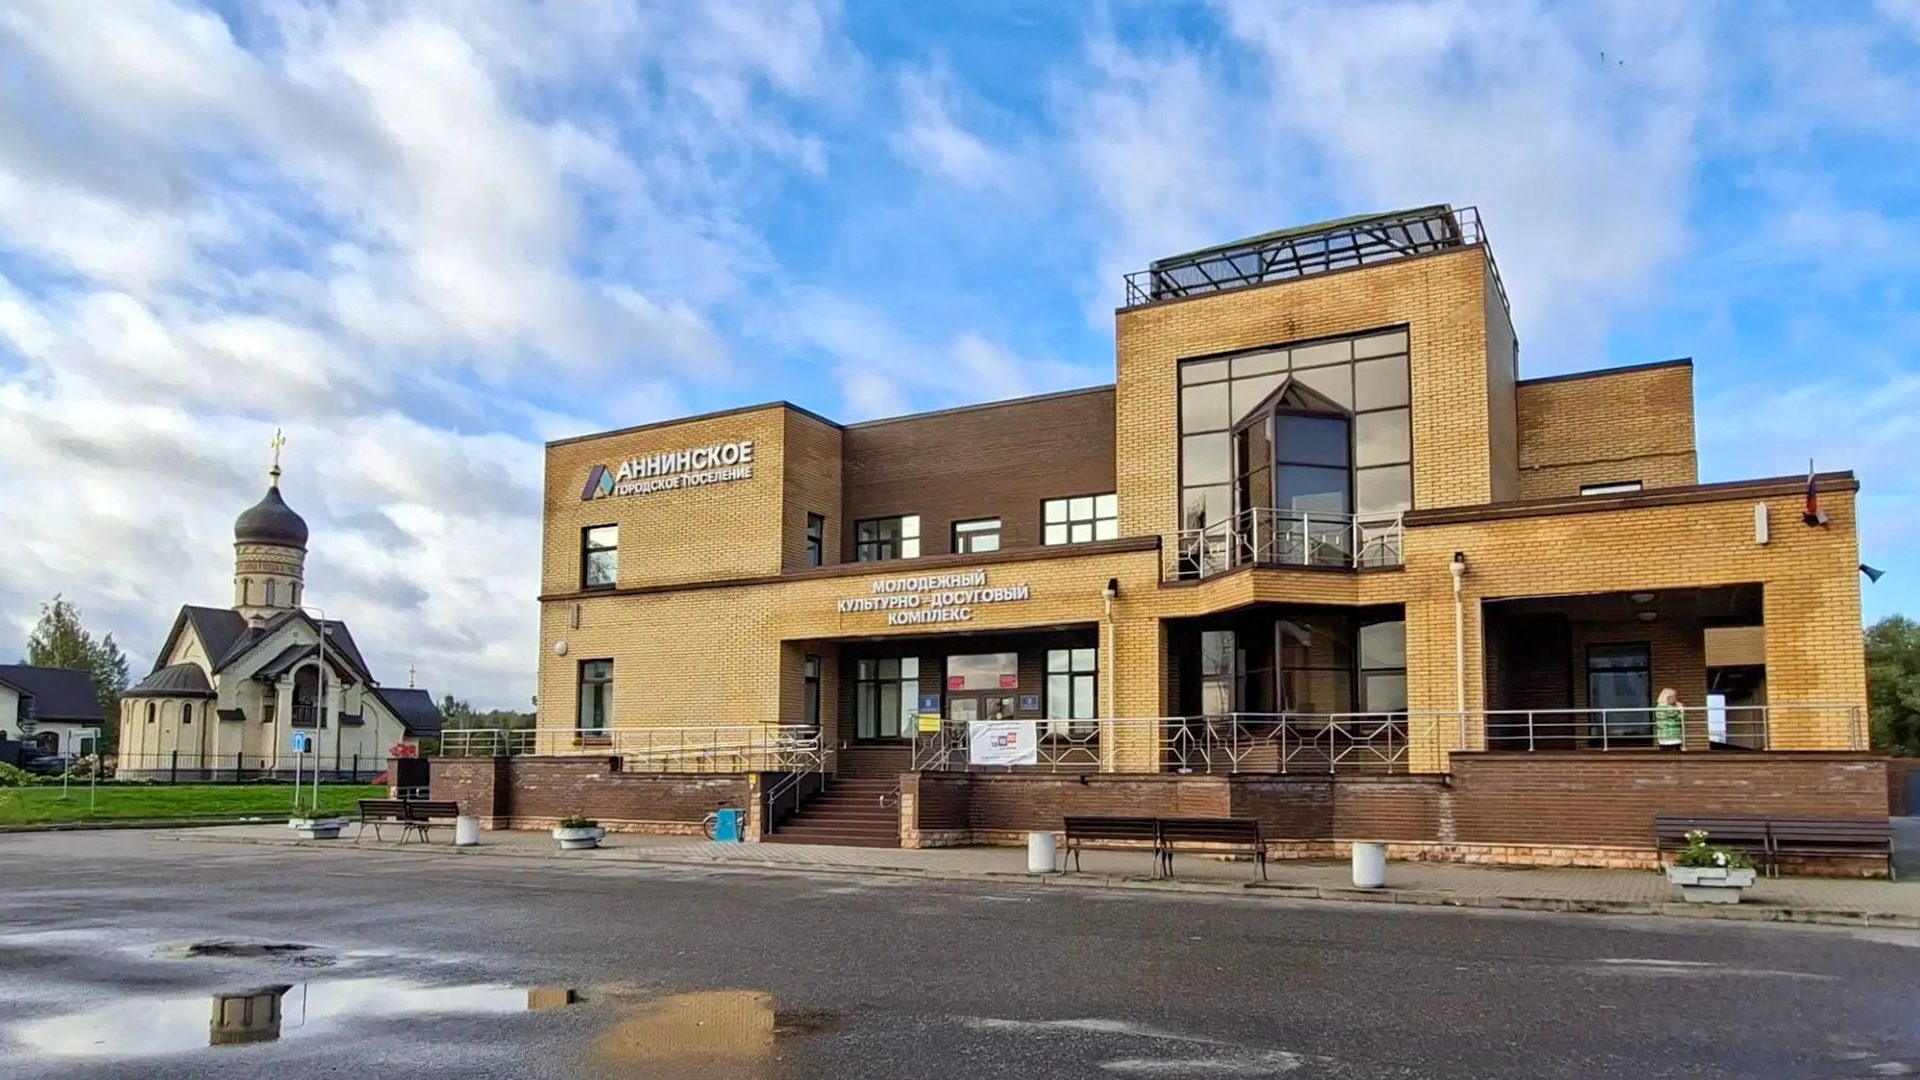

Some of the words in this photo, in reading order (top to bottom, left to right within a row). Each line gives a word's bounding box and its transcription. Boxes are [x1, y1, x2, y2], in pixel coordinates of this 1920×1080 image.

[616, 441, 753, 482] АННИНСКОЕ
[615, 478, 680, 495] ГОРОДСКОЕ
[683, 467, 752, 488] ПОСЕЛЕНИЕ
[873, 569, 986, 593] МОЛОДЕЖНЫЙ
[837, 593, 920, 612] КУЛЬТУРНО
[930, 582, 1029, 607] ДОСУГОВЫЙ
[888, 607, 972, 625] КОМПЛЕКС
